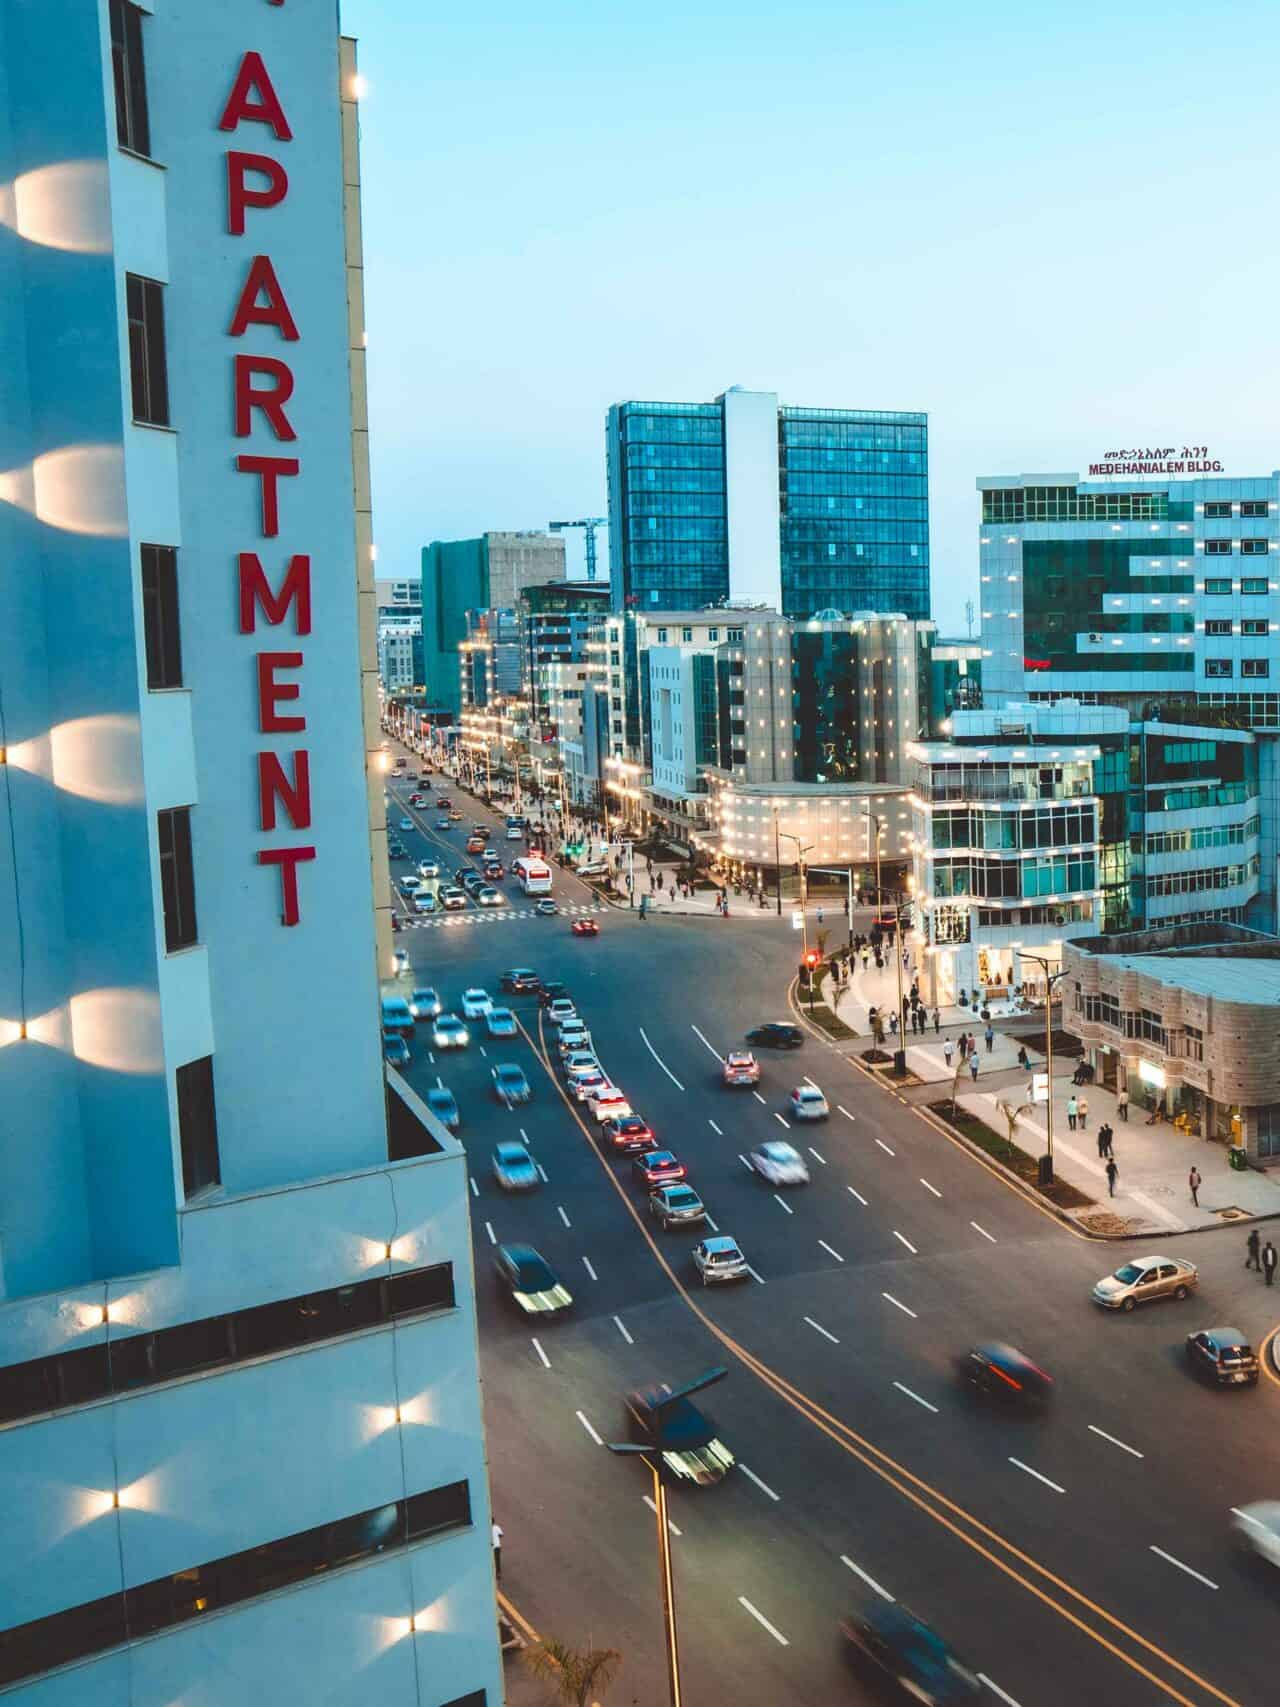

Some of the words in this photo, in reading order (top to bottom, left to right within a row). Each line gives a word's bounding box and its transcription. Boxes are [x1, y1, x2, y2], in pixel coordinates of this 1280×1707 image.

[219, 50, 316, 927] APARTMENT
[1089, 461, 1184, 475] MEDEHANIALEM
[1188, 460, 1225, 473] BLDG.
